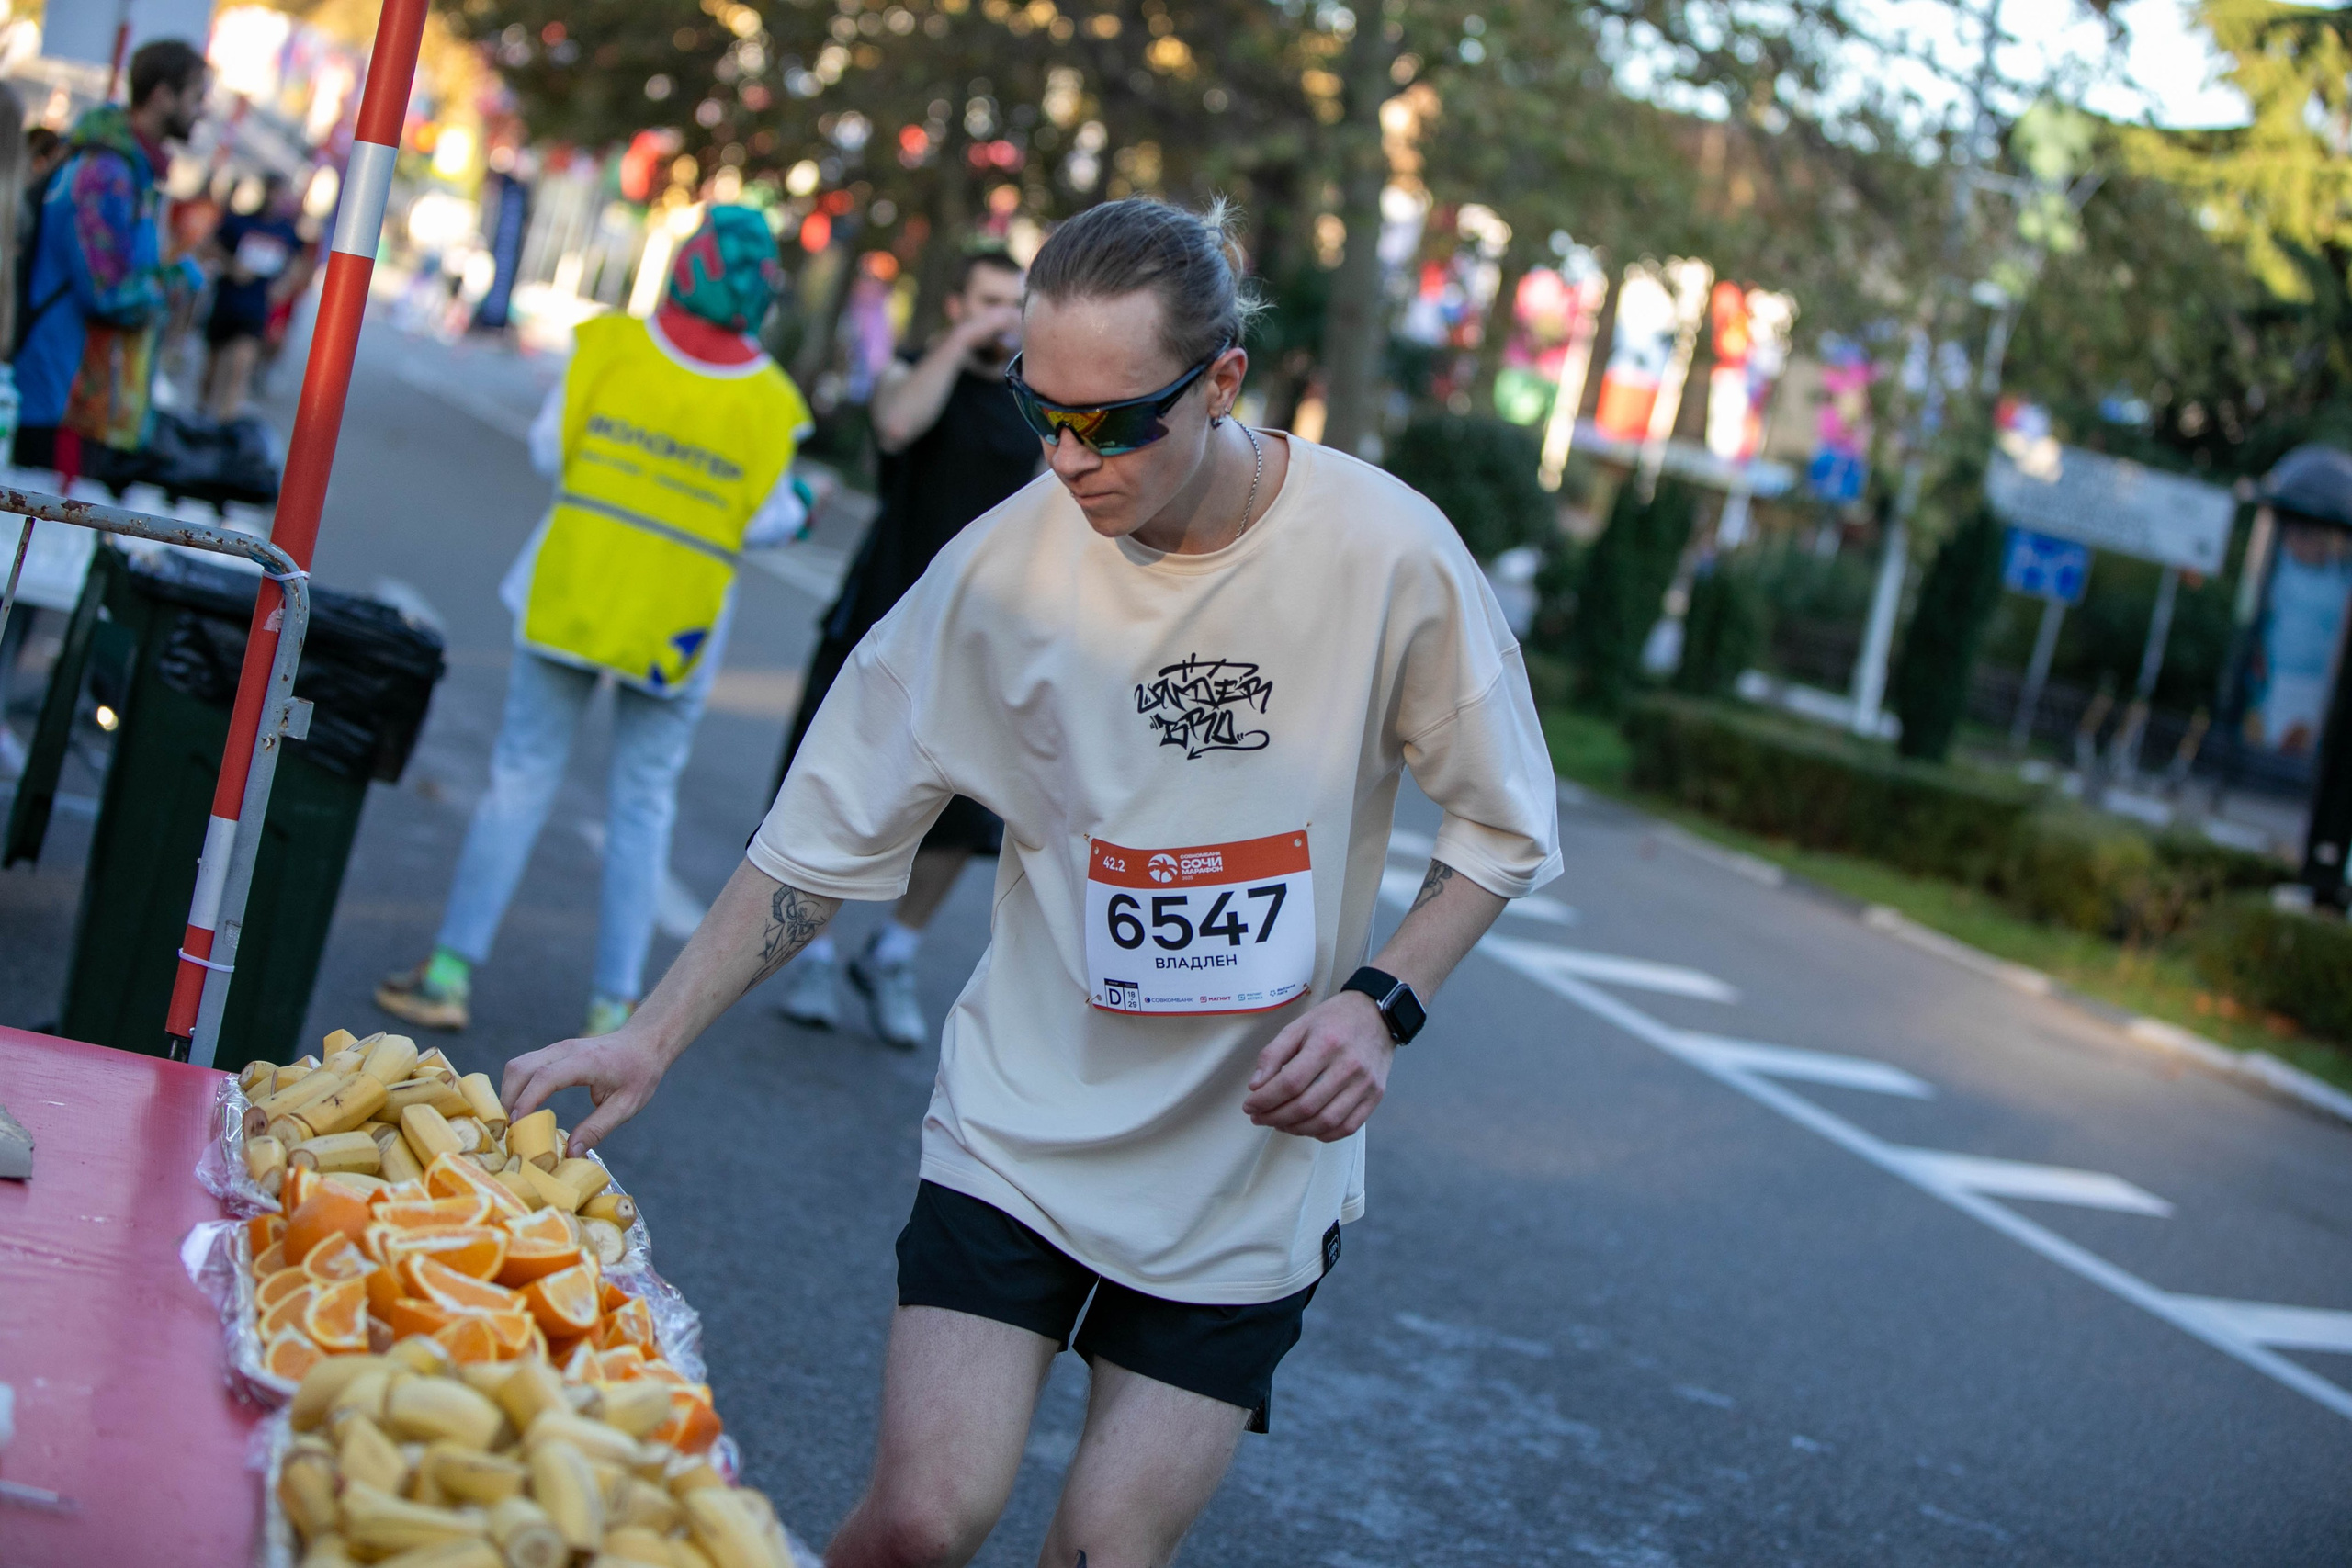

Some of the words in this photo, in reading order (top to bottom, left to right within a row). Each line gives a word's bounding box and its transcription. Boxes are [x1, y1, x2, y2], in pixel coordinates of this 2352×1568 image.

[1103, 855, 1125, 872] 42.2
[1181, 856, 1222, 869] СОЧИ
[1182, 866, 1223, 874] МАРАФОН
[1108, 883, 1287, 951] 6547
[1155, 954, 1238, 970] ВЛАДЛЕН
[1109, 988, 1122, 1005] D
